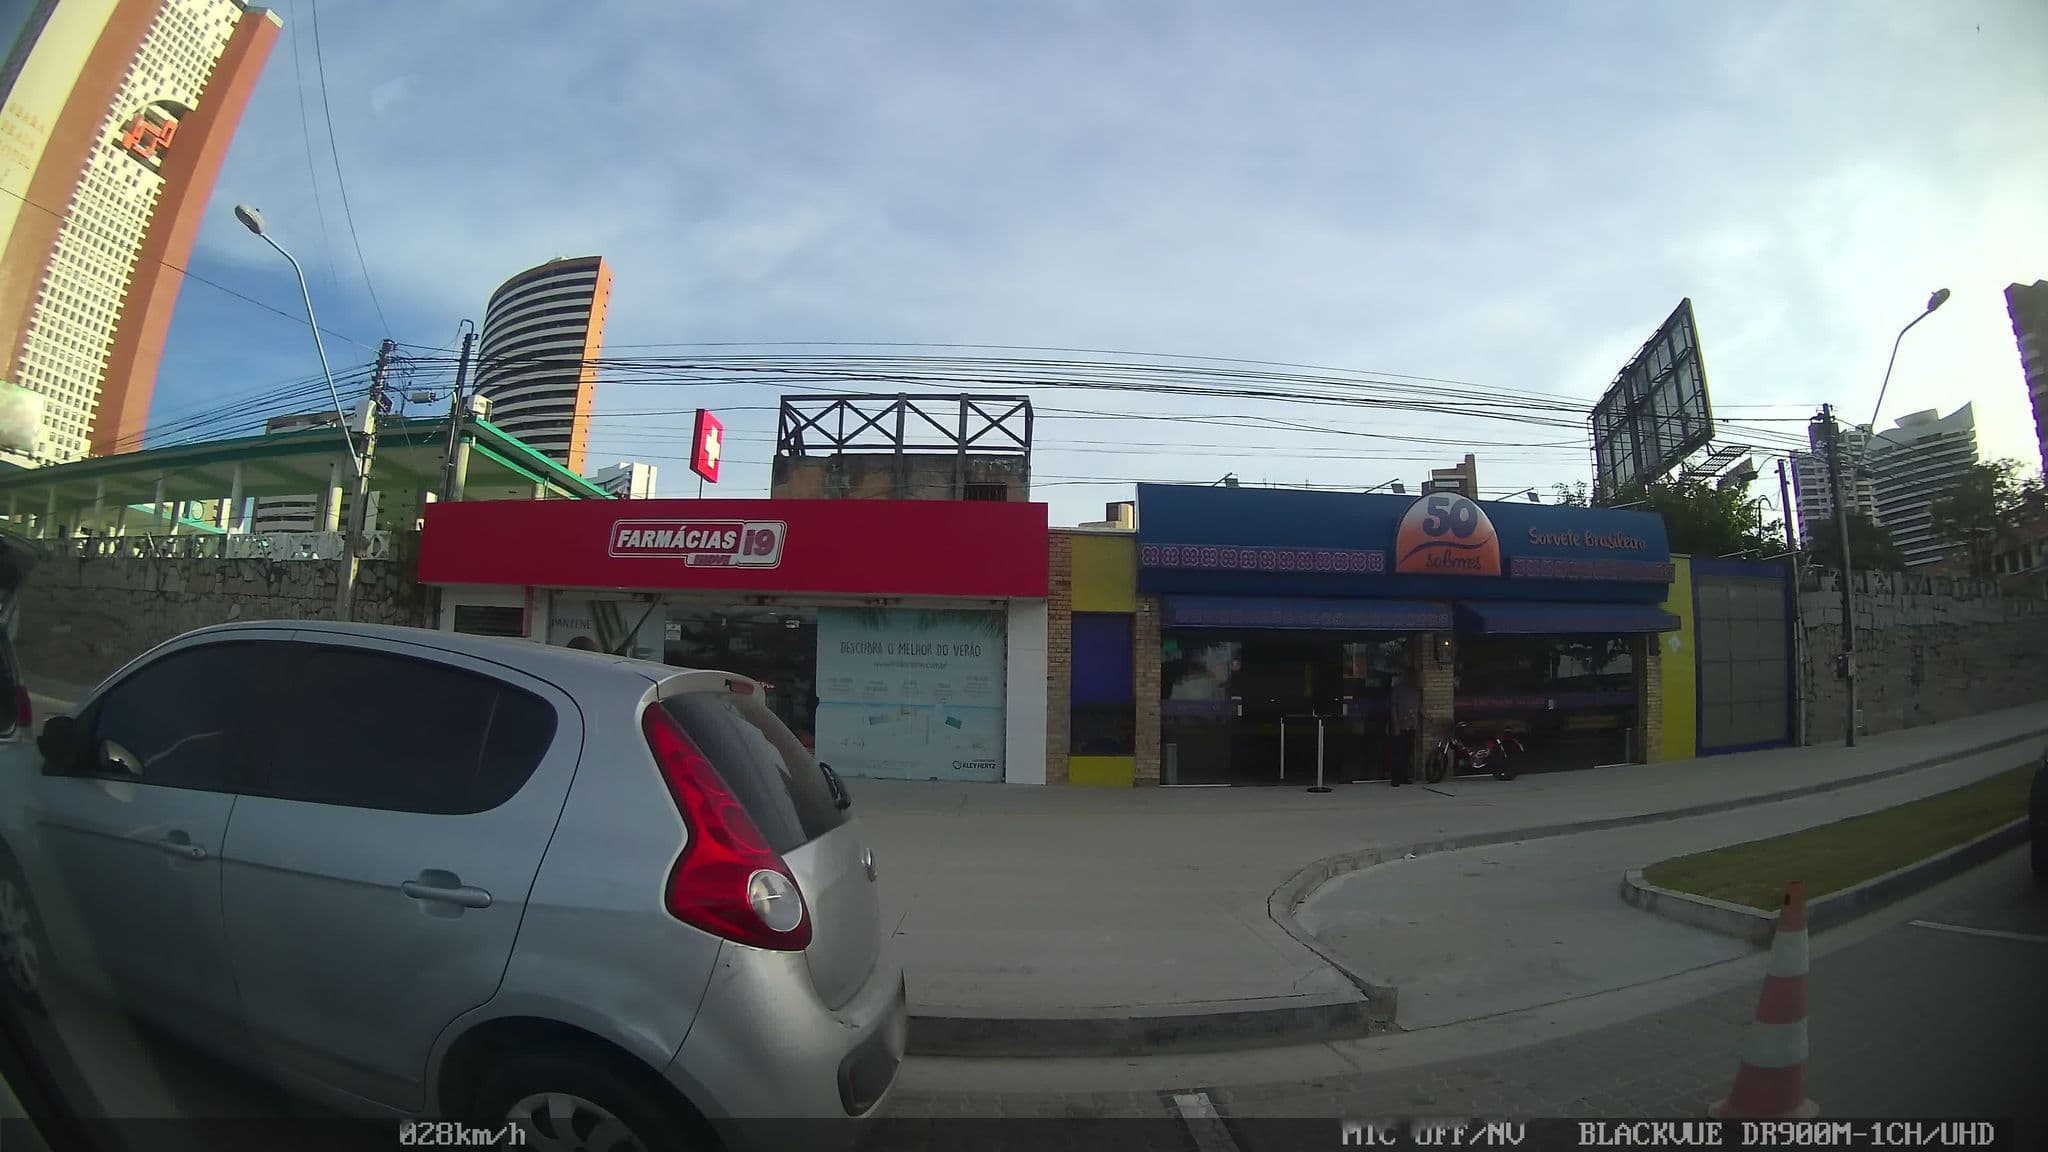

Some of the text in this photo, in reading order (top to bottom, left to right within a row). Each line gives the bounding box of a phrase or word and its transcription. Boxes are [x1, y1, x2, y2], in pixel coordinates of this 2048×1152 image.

[1423, 498, 1478, 538] 50
[616, 526, 737, 550] FARMÁCIAS
[1529, 527, 1581, 547] Sorvete
[1425, 549, 1481, 570] sabores
[551, 617, 593, 630] PANTENE
[840, 641, 883, 655] DESCUBRA
[887, 643, 894, 655] O
[898, 643, 932, 656] MELHOR
[937, 644, 949, 656] DO
